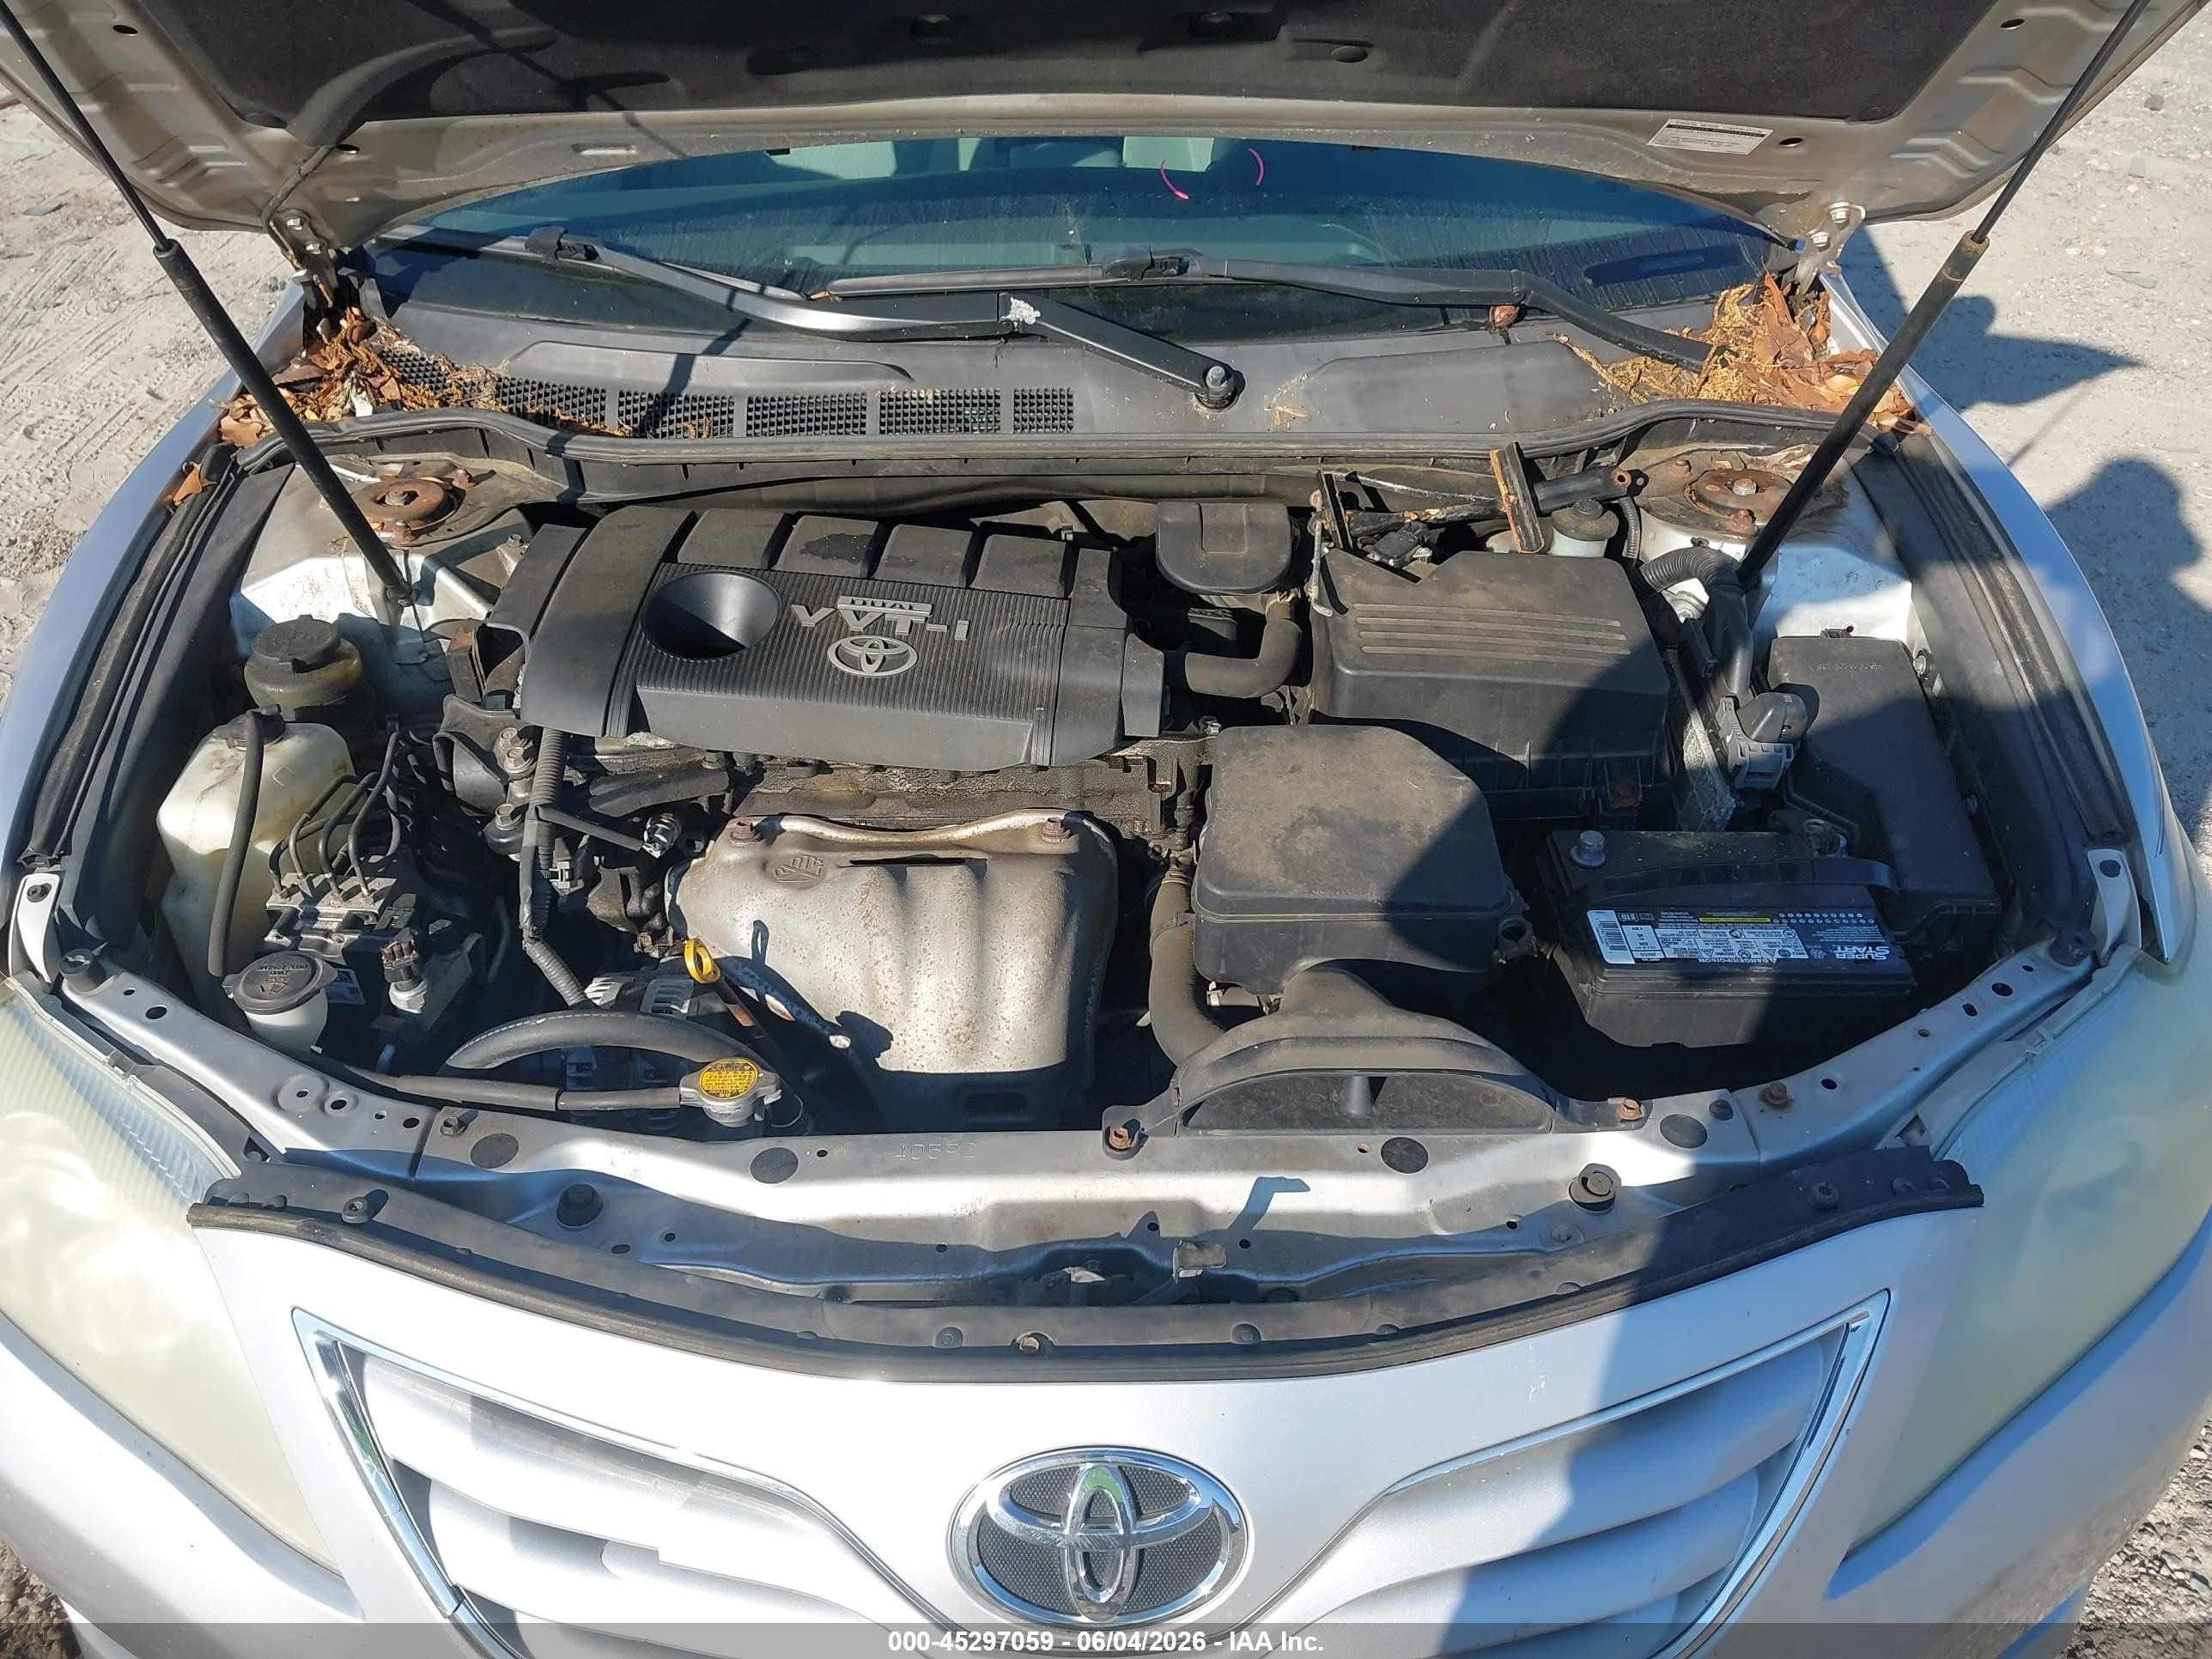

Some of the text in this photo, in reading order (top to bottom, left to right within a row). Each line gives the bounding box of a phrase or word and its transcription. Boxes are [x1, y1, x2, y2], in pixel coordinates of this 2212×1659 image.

[845, 597, 928, 612] DUAL
[1832, 945, 1890, 955] START
[1835, 952, 1887, 961] SUPER
